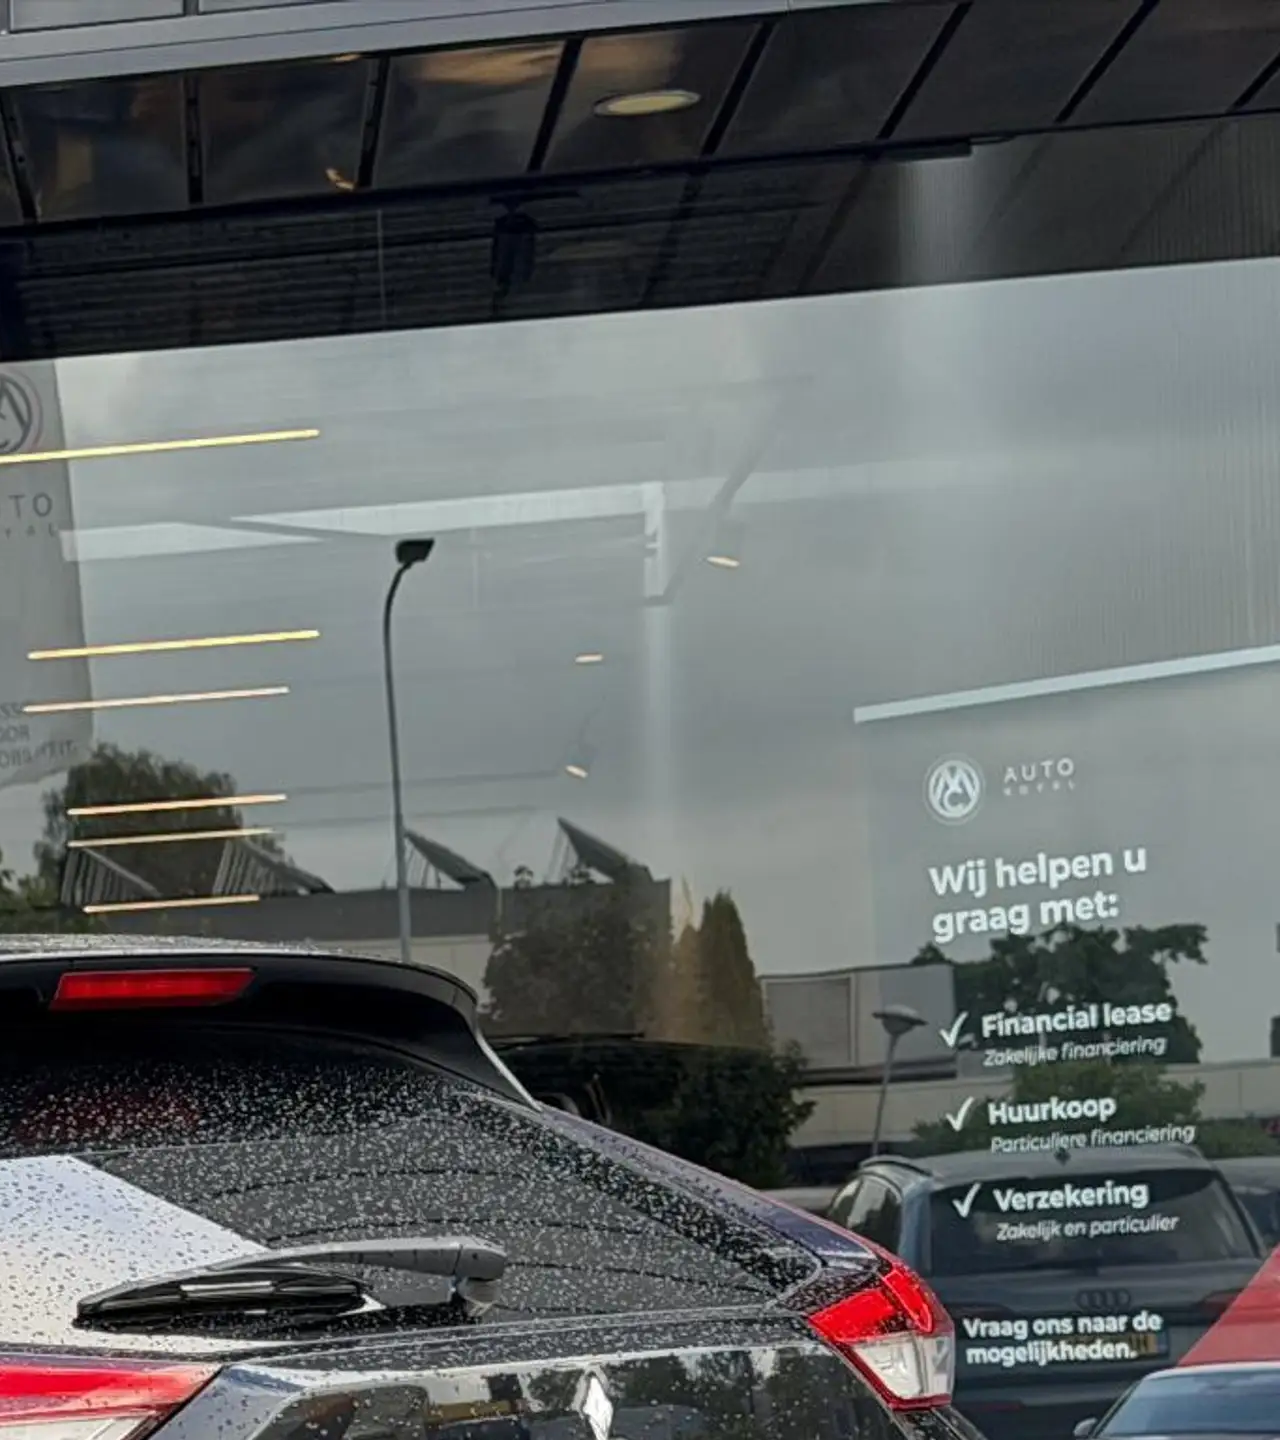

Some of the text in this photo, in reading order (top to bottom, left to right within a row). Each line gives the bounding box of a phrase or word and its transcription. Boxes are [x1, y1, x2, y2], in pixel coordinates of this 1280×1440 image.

[1004, 757, 1074, 784] AUTO
[928, 848, 1147, 898] Wij helpen u
[932, 890, 1120, 944] graag met:
[981, 1002, 1173, 1038] Financial lease
[983, 1036, 1168, 1067] Zakelijke financiering
[989, 1096, 1117, 1126] Huurkoop
[991, 1124, 1196, 1153] Particuliere financiering
[992, 1180, 1149, 1212] Verzekering
[996, 1213, 1180, 1241] Zakelijk en particulier
[963, 1310, 1164, 1340] Vraag ons naar de
[966, 1339, 1139, 1368] mogelijkheden.
